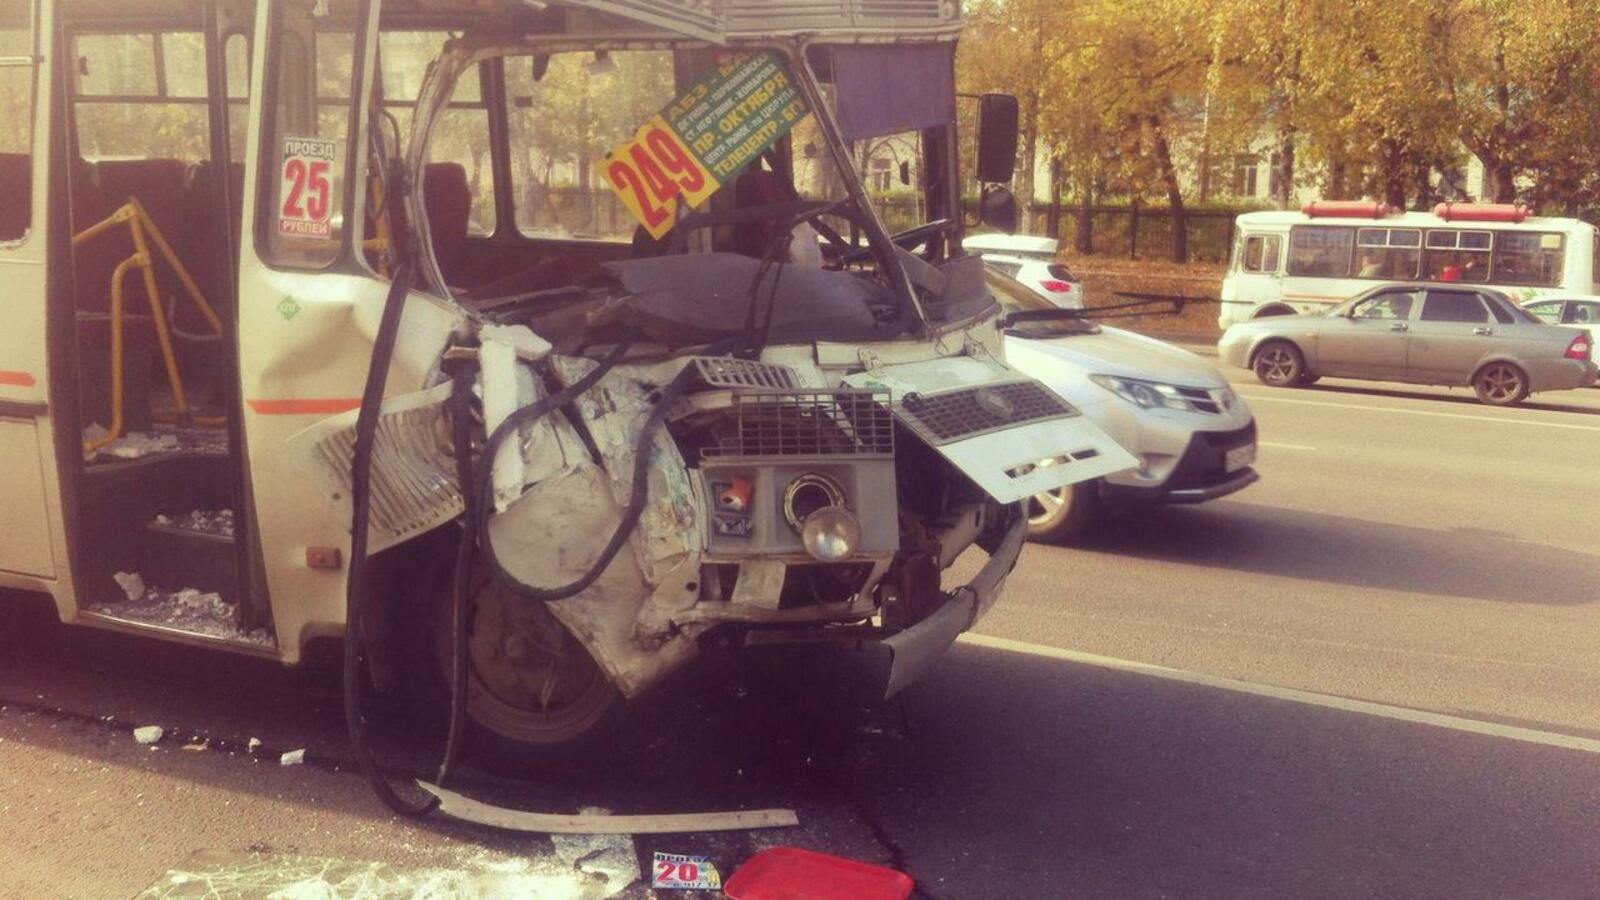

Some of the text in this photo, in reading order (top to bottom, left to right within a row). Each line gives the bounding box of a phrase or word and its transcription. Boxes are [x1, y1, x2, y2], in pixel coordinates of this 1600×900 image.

[719, 71, 788, 133] ОКТЯБРЯ
[284, 140, 335, 161] ПРОЕЗД
[713, 120, 778, 176] ТЕЛЕЦЕНТР
[282, 159, 330, 222] 25
[608, 128, 705, 228] 249
[281, 220, 329, 236] РУБЛЕЙ
[656, 860, 699, 882] 20
